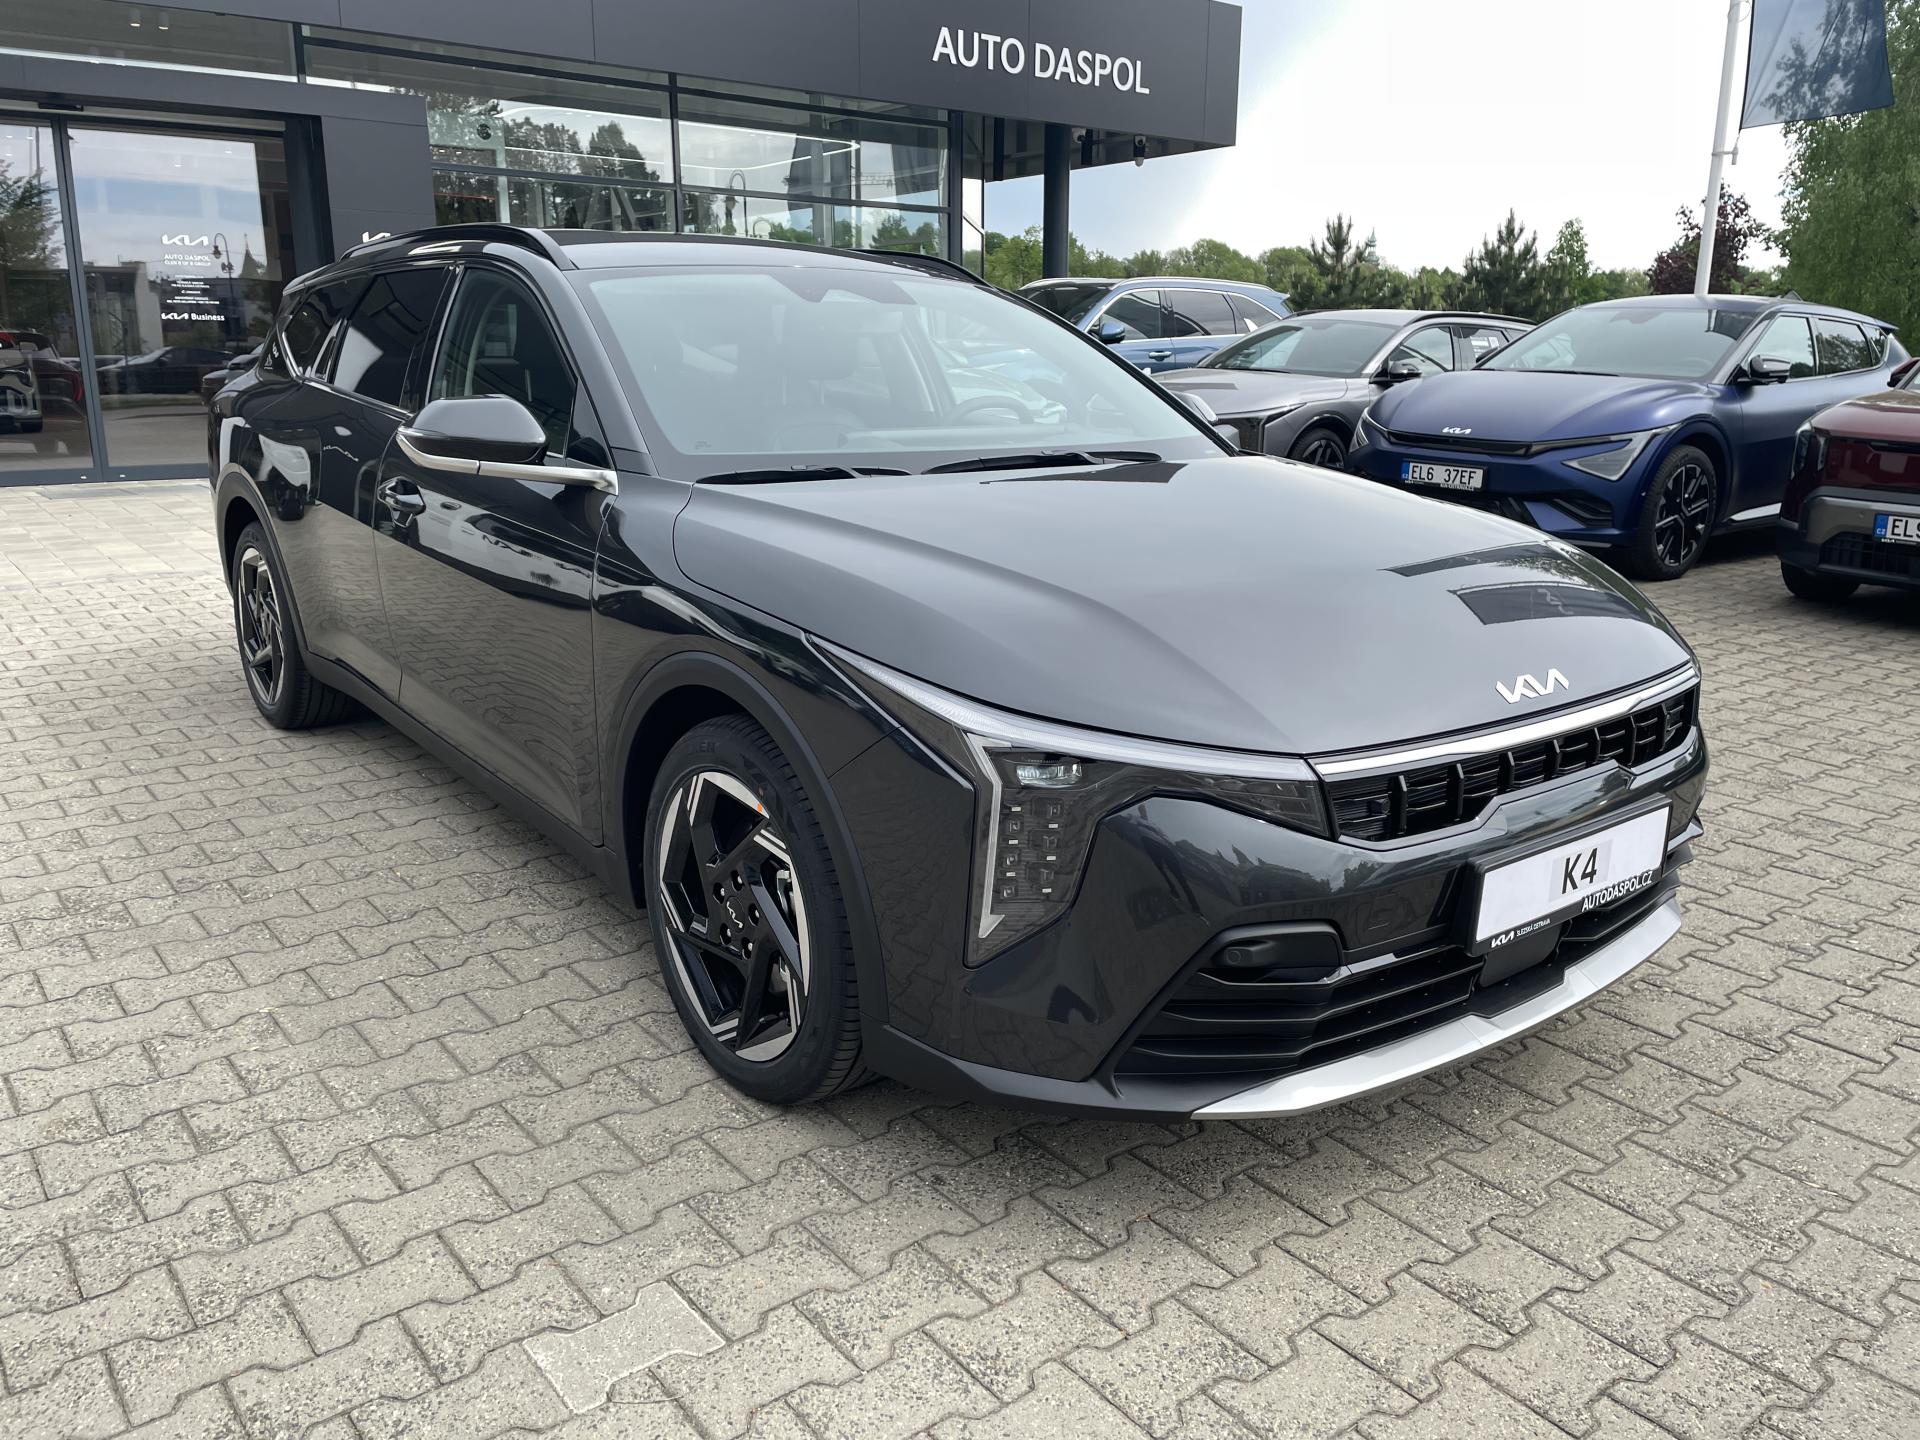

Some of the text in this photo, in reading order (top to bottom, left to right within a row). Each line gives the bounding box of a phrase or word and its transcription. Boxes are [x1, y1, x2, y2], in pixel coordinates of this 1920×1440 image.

[932, 26, 1150, 94] AUTO DASPOL
[162, 234, 209, 246] KIA
[161, 312, 225, 321] KIA Business
[1442, 426, 1472, 435] KIA
[1411, 465, 1434, 481] EL6
[1443, 468, 1477, 485] 37EF
[1495, 668, 1569, 704] KIA
[1562, 848, 1598, 895] K4
[1581, 870, 1653, 913] AUTODASPOL.CZ
[1491, 930, 1515, 948] KIA
